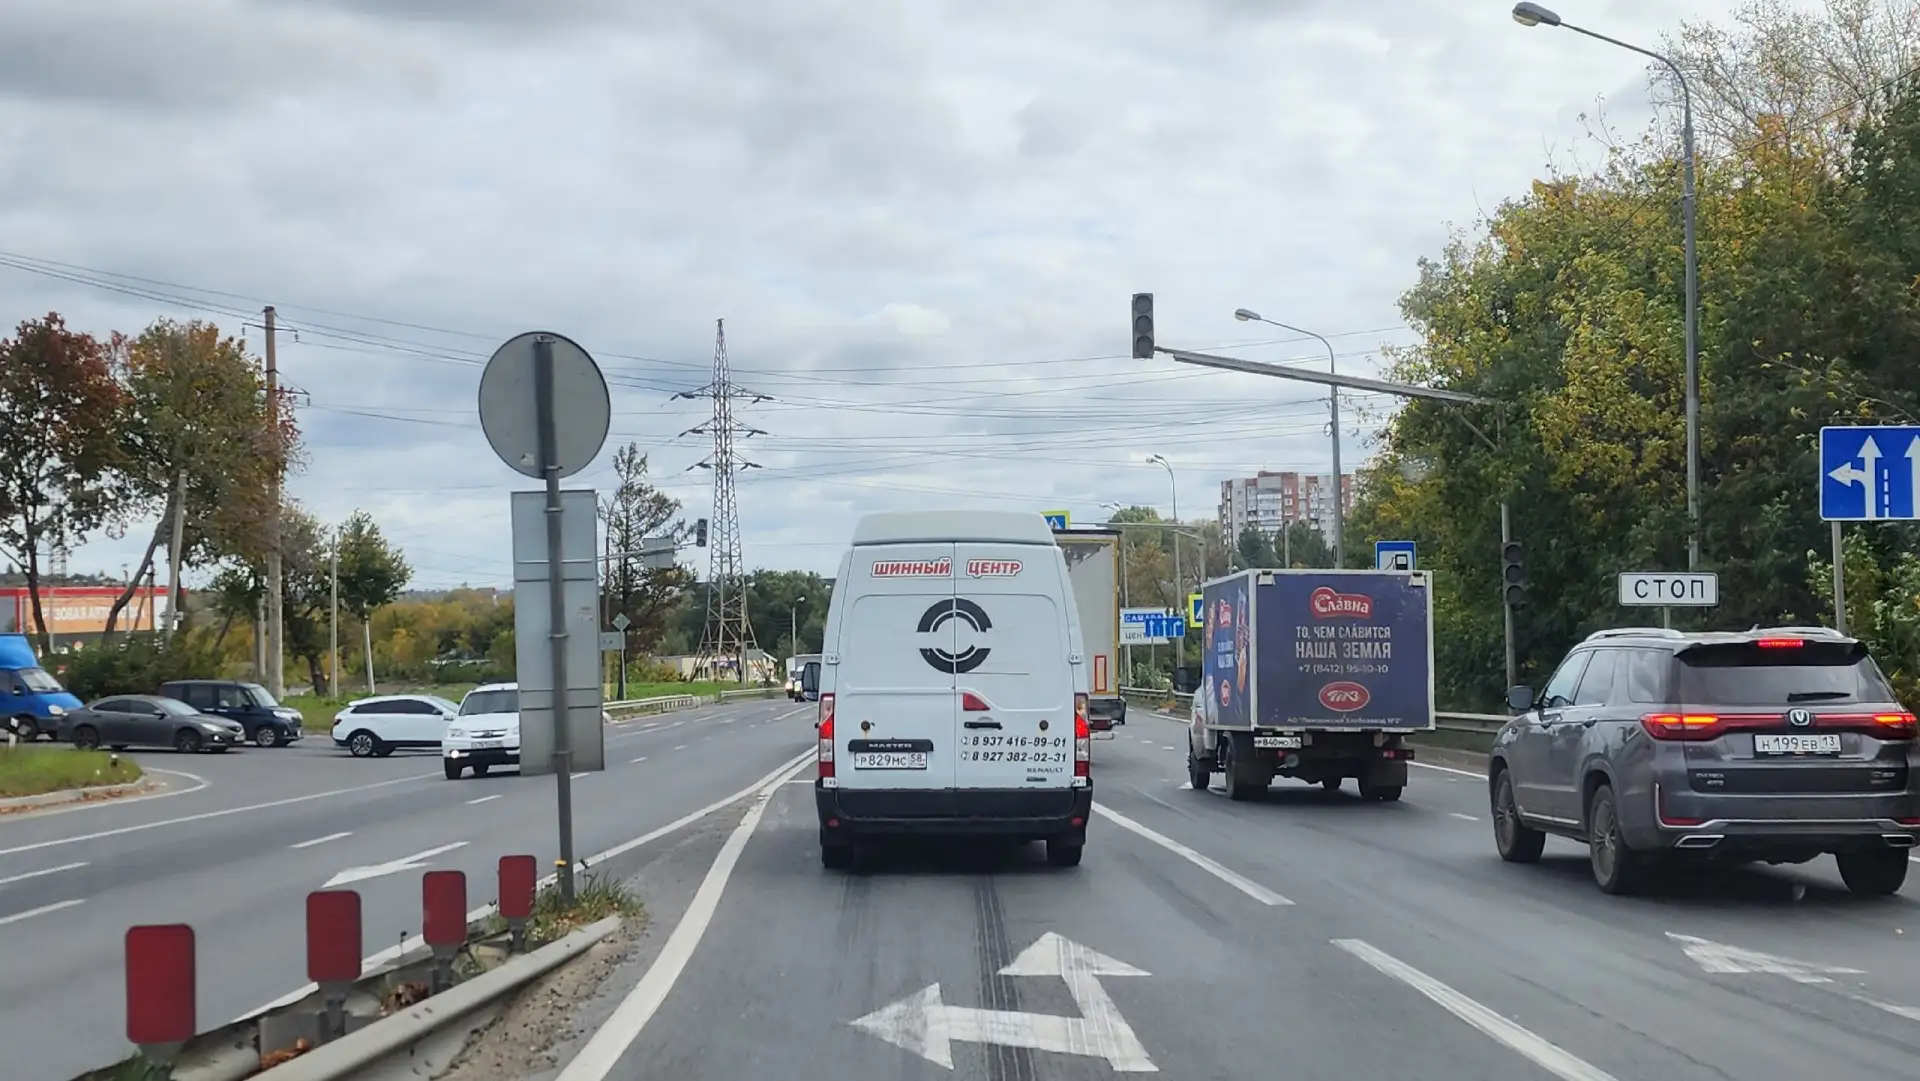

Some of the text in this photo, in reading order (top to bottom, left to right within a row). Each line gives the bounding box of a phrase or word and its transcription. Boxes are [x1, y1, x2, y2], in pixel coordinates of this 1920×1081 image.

[873, 558, 1022, 578] ШИННЫЙ ЦЕНТР
[1633, 579, 1705, 599] СТОП
[1295, 626, 1311, 639] ТО,
[1314, 626, 1335, 638] ЧЕМ
[1295, 641, 1391, 659] НАША ЗЕМЛЯ
[972, 736, 1067, 747] 8 937 416-89-01
[910, 753, 923, 763] 58
[972, 751, 1067, 762] 8 927 382-02-31
